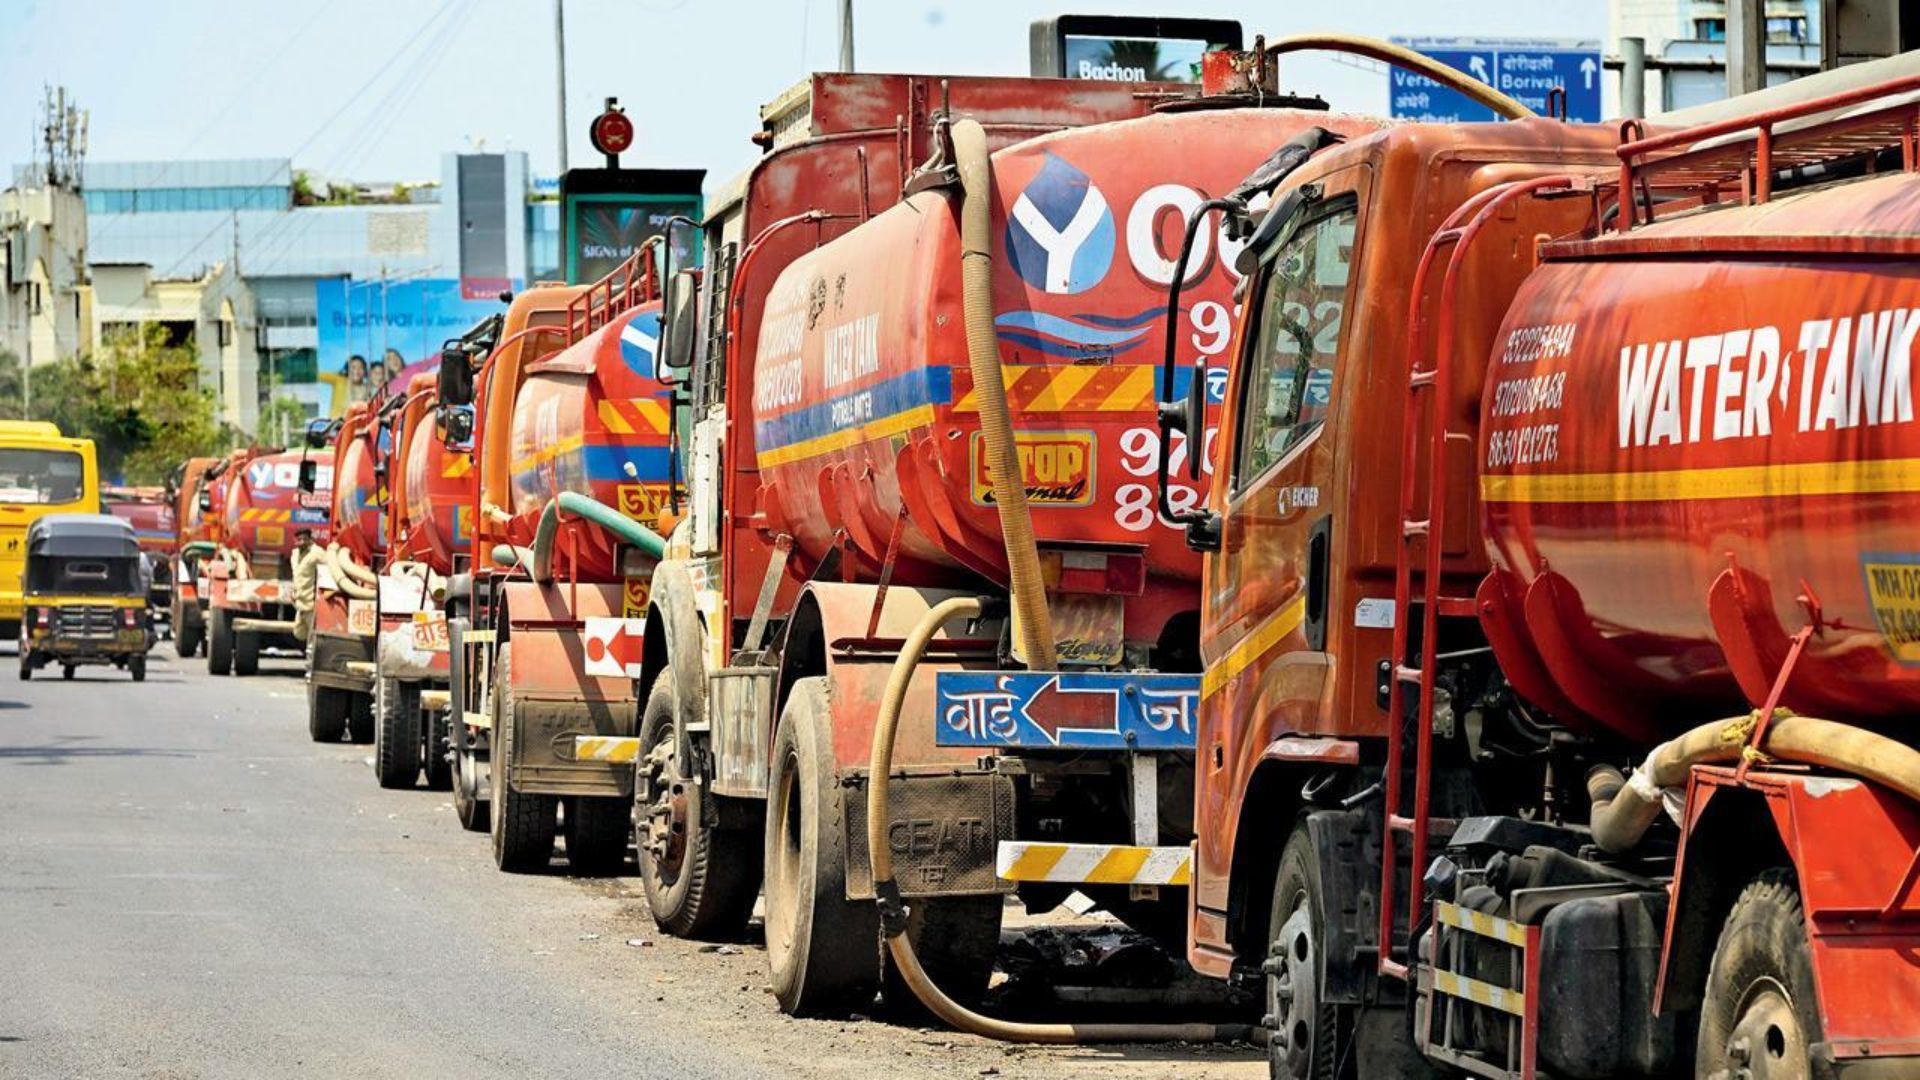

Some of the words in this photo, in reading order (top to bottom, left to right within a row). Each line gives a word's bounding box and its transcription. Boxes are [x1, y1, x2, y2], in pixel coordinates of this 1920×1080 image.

[1502, 75, 1565, 90] Borivali
[1619, 326, 1782, 449] WATER
[1798, 308, 1920, 433] TANK
[983, 444, 1084, 483] TOP
[1292, 486, 1320, 508] EICHER
[888, 817, 982, 855] CEAT
